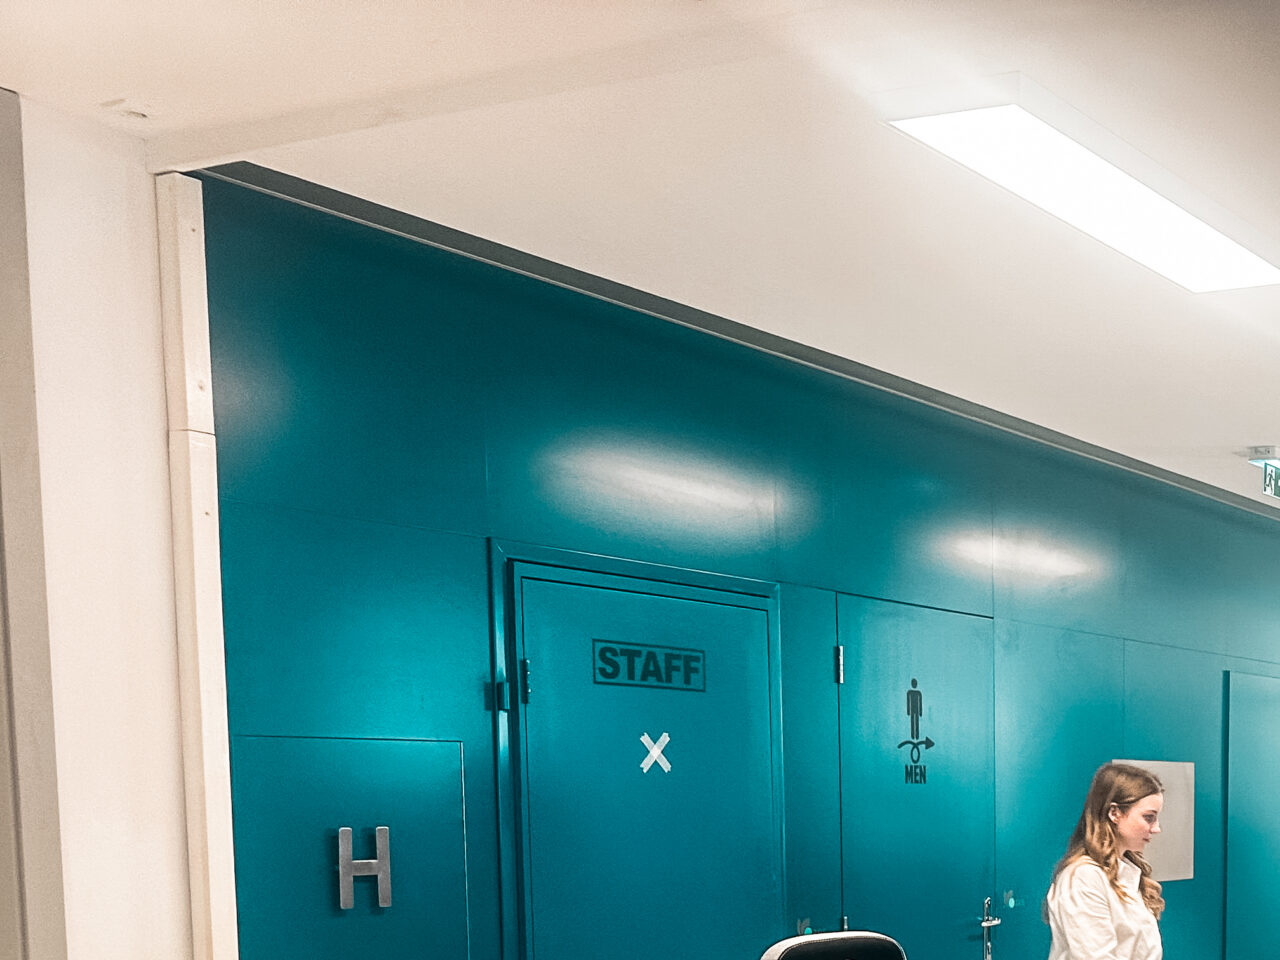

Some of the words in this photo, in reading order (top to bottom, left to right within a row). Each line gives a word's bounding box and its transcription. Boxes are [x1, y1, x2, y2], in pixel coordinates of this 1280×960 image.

[598, 646, 701, 685] STAFF
[905, 764, 926, 785] MEN
[339, 826, 392, 909] H
